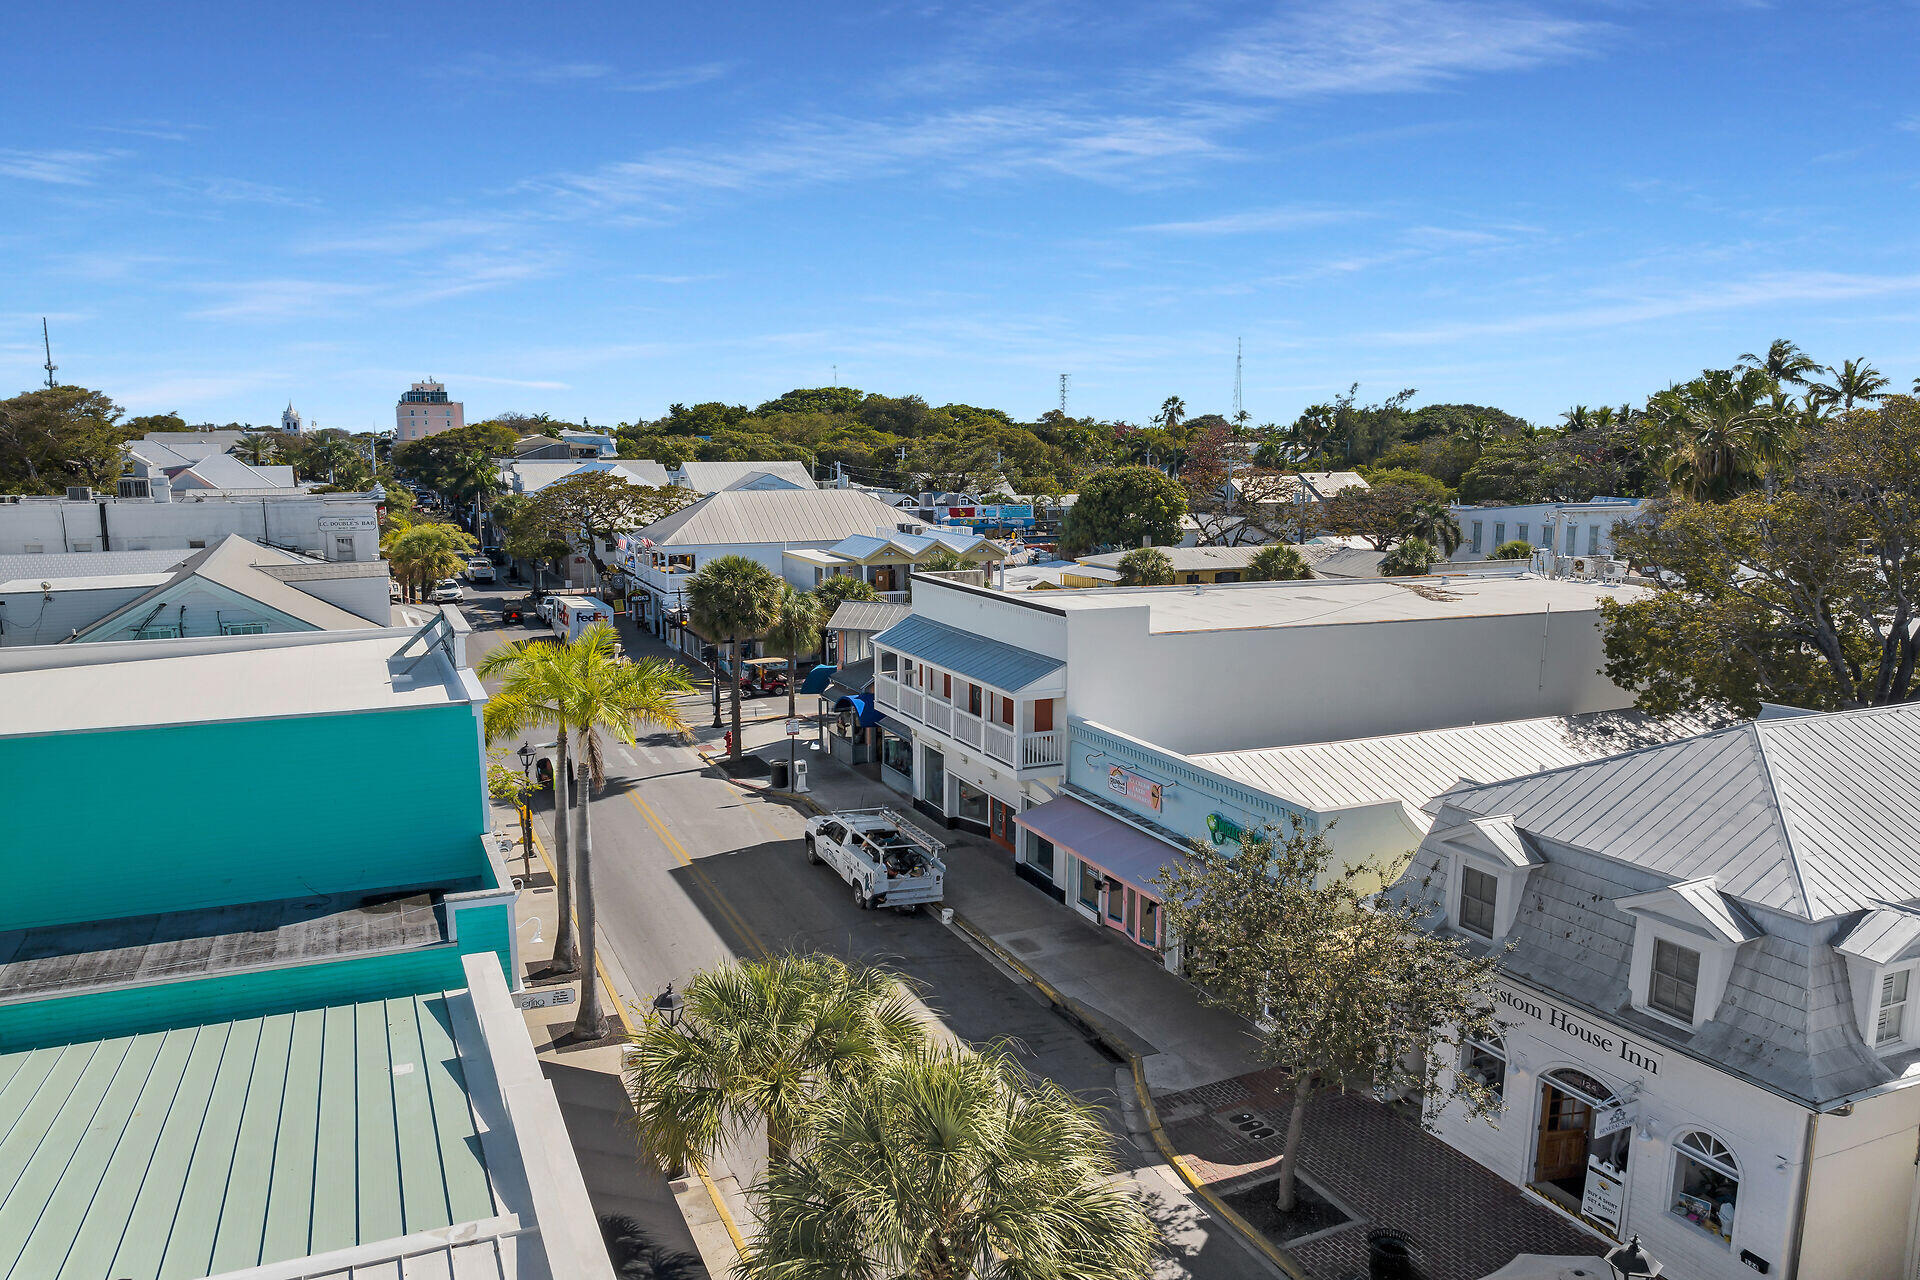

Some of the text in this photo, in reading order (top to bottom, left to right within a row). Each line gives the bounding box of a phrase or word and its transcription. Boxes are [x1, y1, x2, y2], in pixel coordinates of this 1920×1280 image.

[576, 611, 609, 622] FedEx
[1549, 1007, 1613, 1053] House
[1619, 1039, 1659, 1076] Inn
[1587, 1189, 1598, 1198] BUY
[1603, 1197, 1618, 1210] SHIRT
[1587, 1196, 1597, 1205] GET
[1602, 1204, 1617, 1216] SHOT
